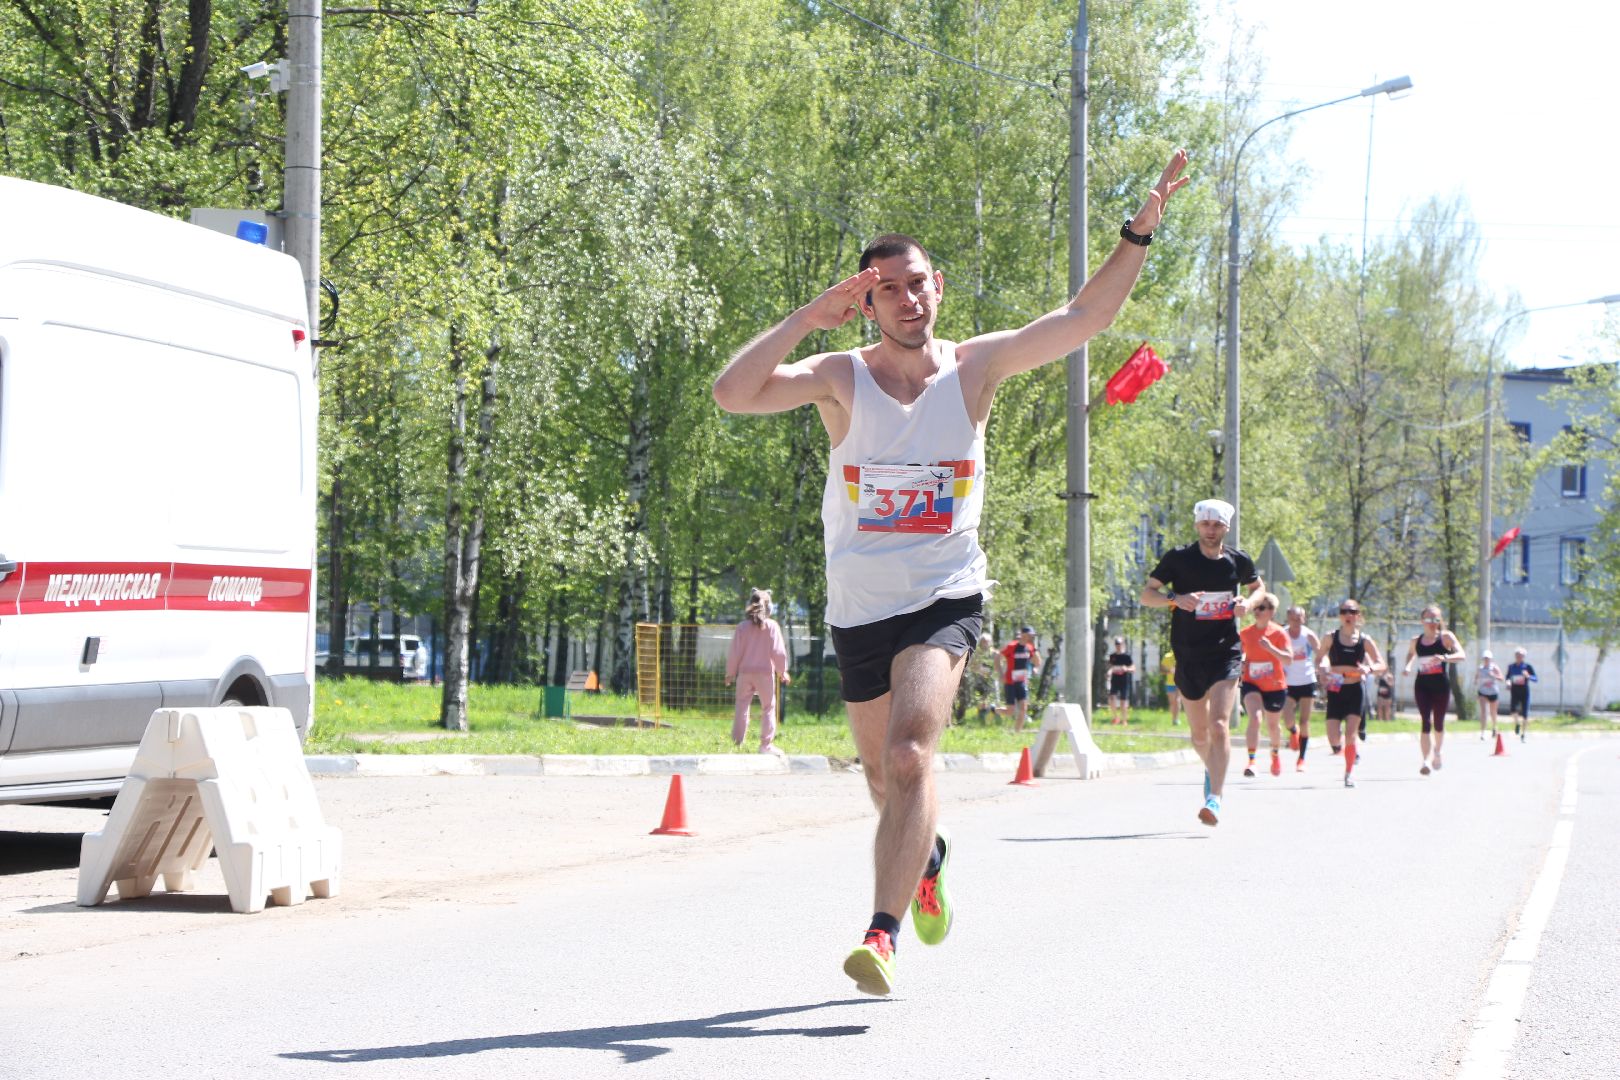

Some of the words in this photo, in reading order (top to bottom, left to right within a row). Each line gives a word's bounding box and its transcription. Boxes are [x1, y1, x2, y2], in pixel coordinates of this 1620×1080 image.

[874, 489, 939, 518] 371
[44, 573, 161, 607] МЕДИЦИНСКАЯ
[207, 576, 263, 606] ПОМОЩЬ
